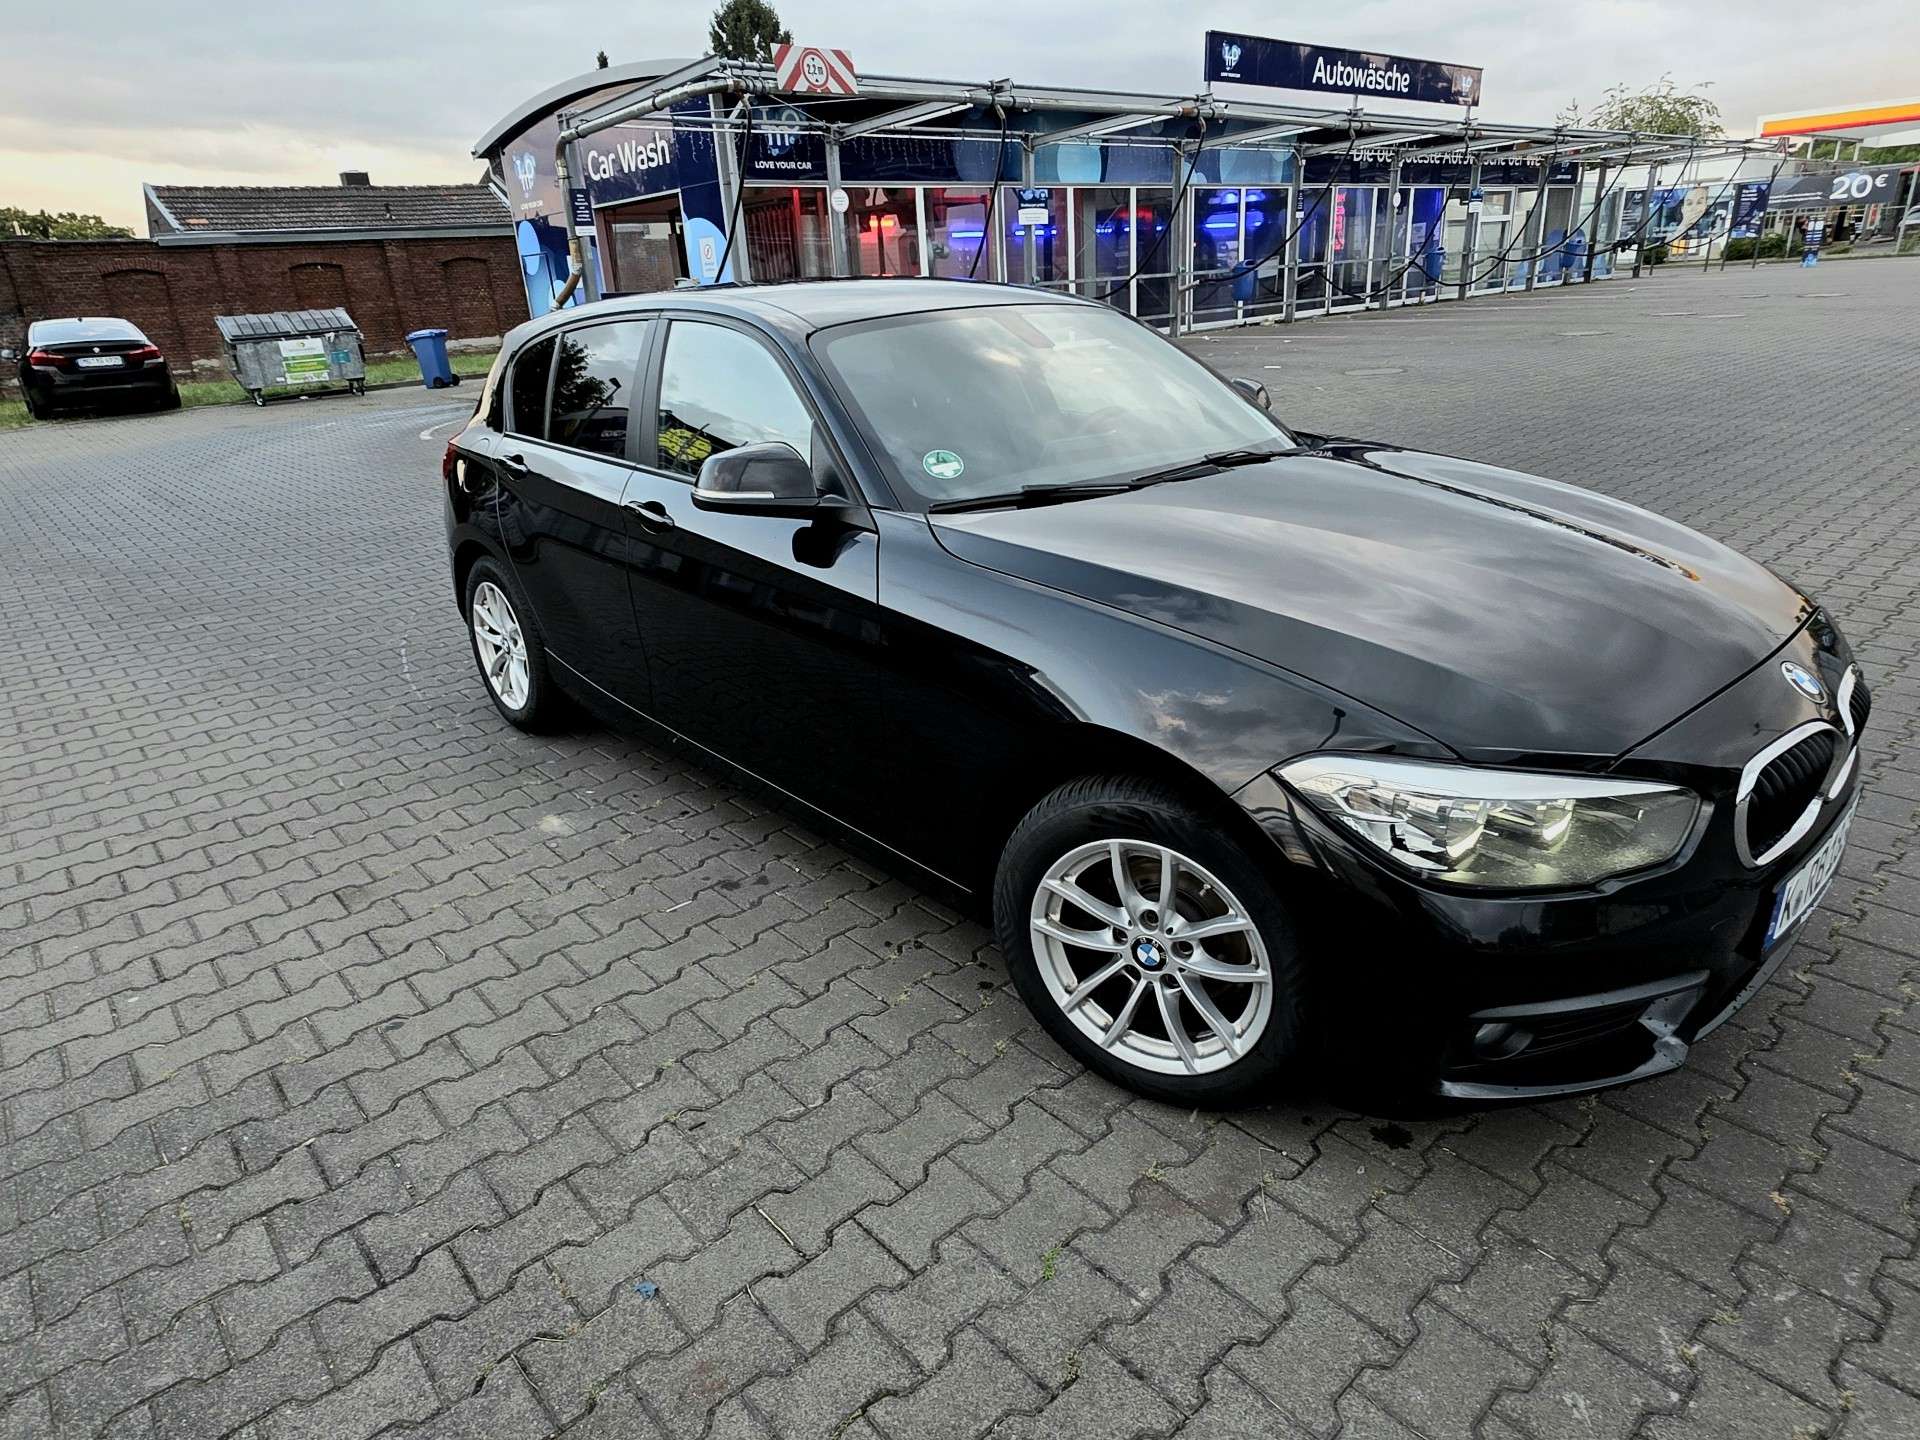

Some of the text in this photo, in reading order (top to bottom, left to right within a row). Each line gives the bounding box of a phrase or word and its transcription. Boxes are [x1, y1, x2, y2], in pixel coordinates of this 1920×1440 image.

[1312, 56, 1410, 93] Autowäsche
[587, 131, 671, 181] Car Wash
[754, 160, 812, 170] LOVE YOUR CAR
